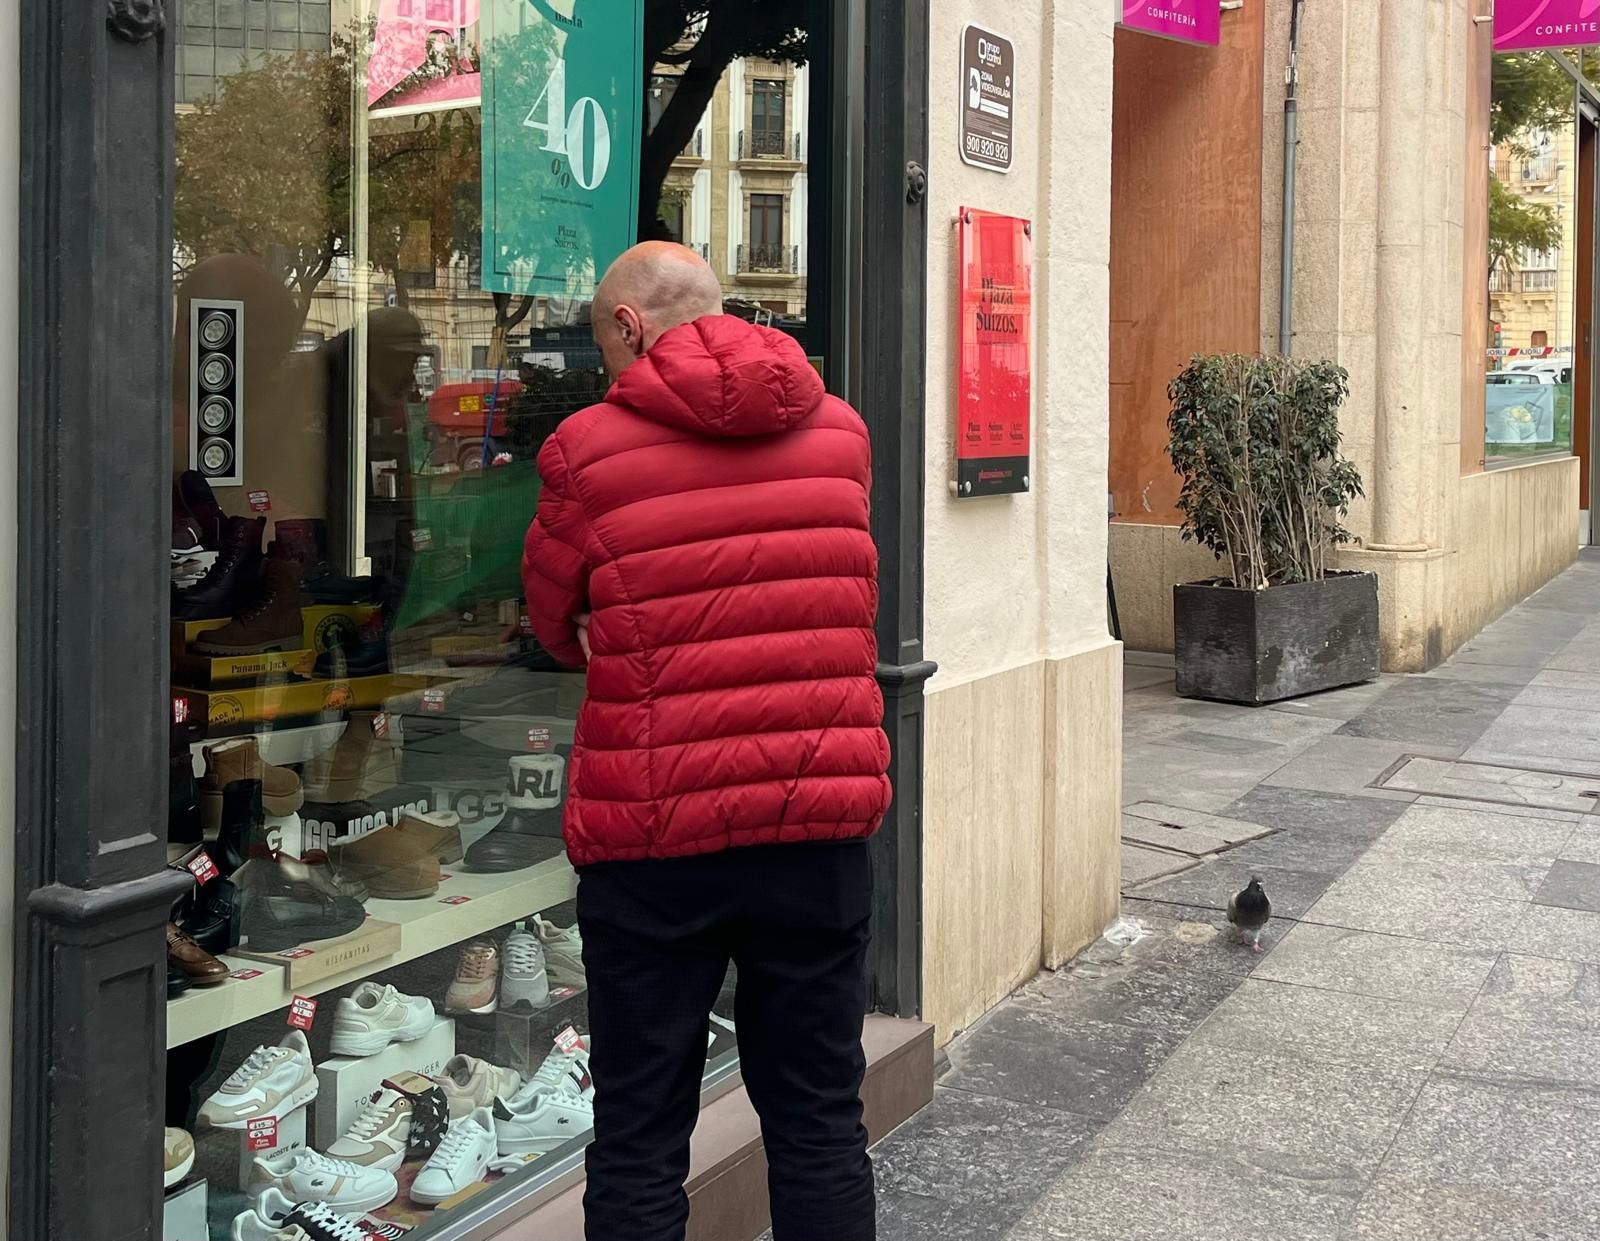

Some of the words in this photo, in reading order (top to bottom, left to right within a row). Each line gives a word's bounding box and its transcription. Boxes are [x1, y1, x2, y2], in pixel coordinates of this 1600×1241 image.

[1147, 6, 1196, 27] CONFITERÍA
[1535, 22, 1597, 36] CONFITE
[523, 58, 610, 190] 40
[966, 135, 980, 152] 900
[981, 139, 994, 156] 920
[995, 143, 1009, 161] 920
[981, 277, 1014, 305] Plaza
[976, 305, 1018, 334] Suizos.
[231, 662, 266, 674] Panama
[269, 659, 288, 672] Jack
[325, 943, 371, 966] HISPANITAS
[266, 1146, 289, 1161] LACOSTE
